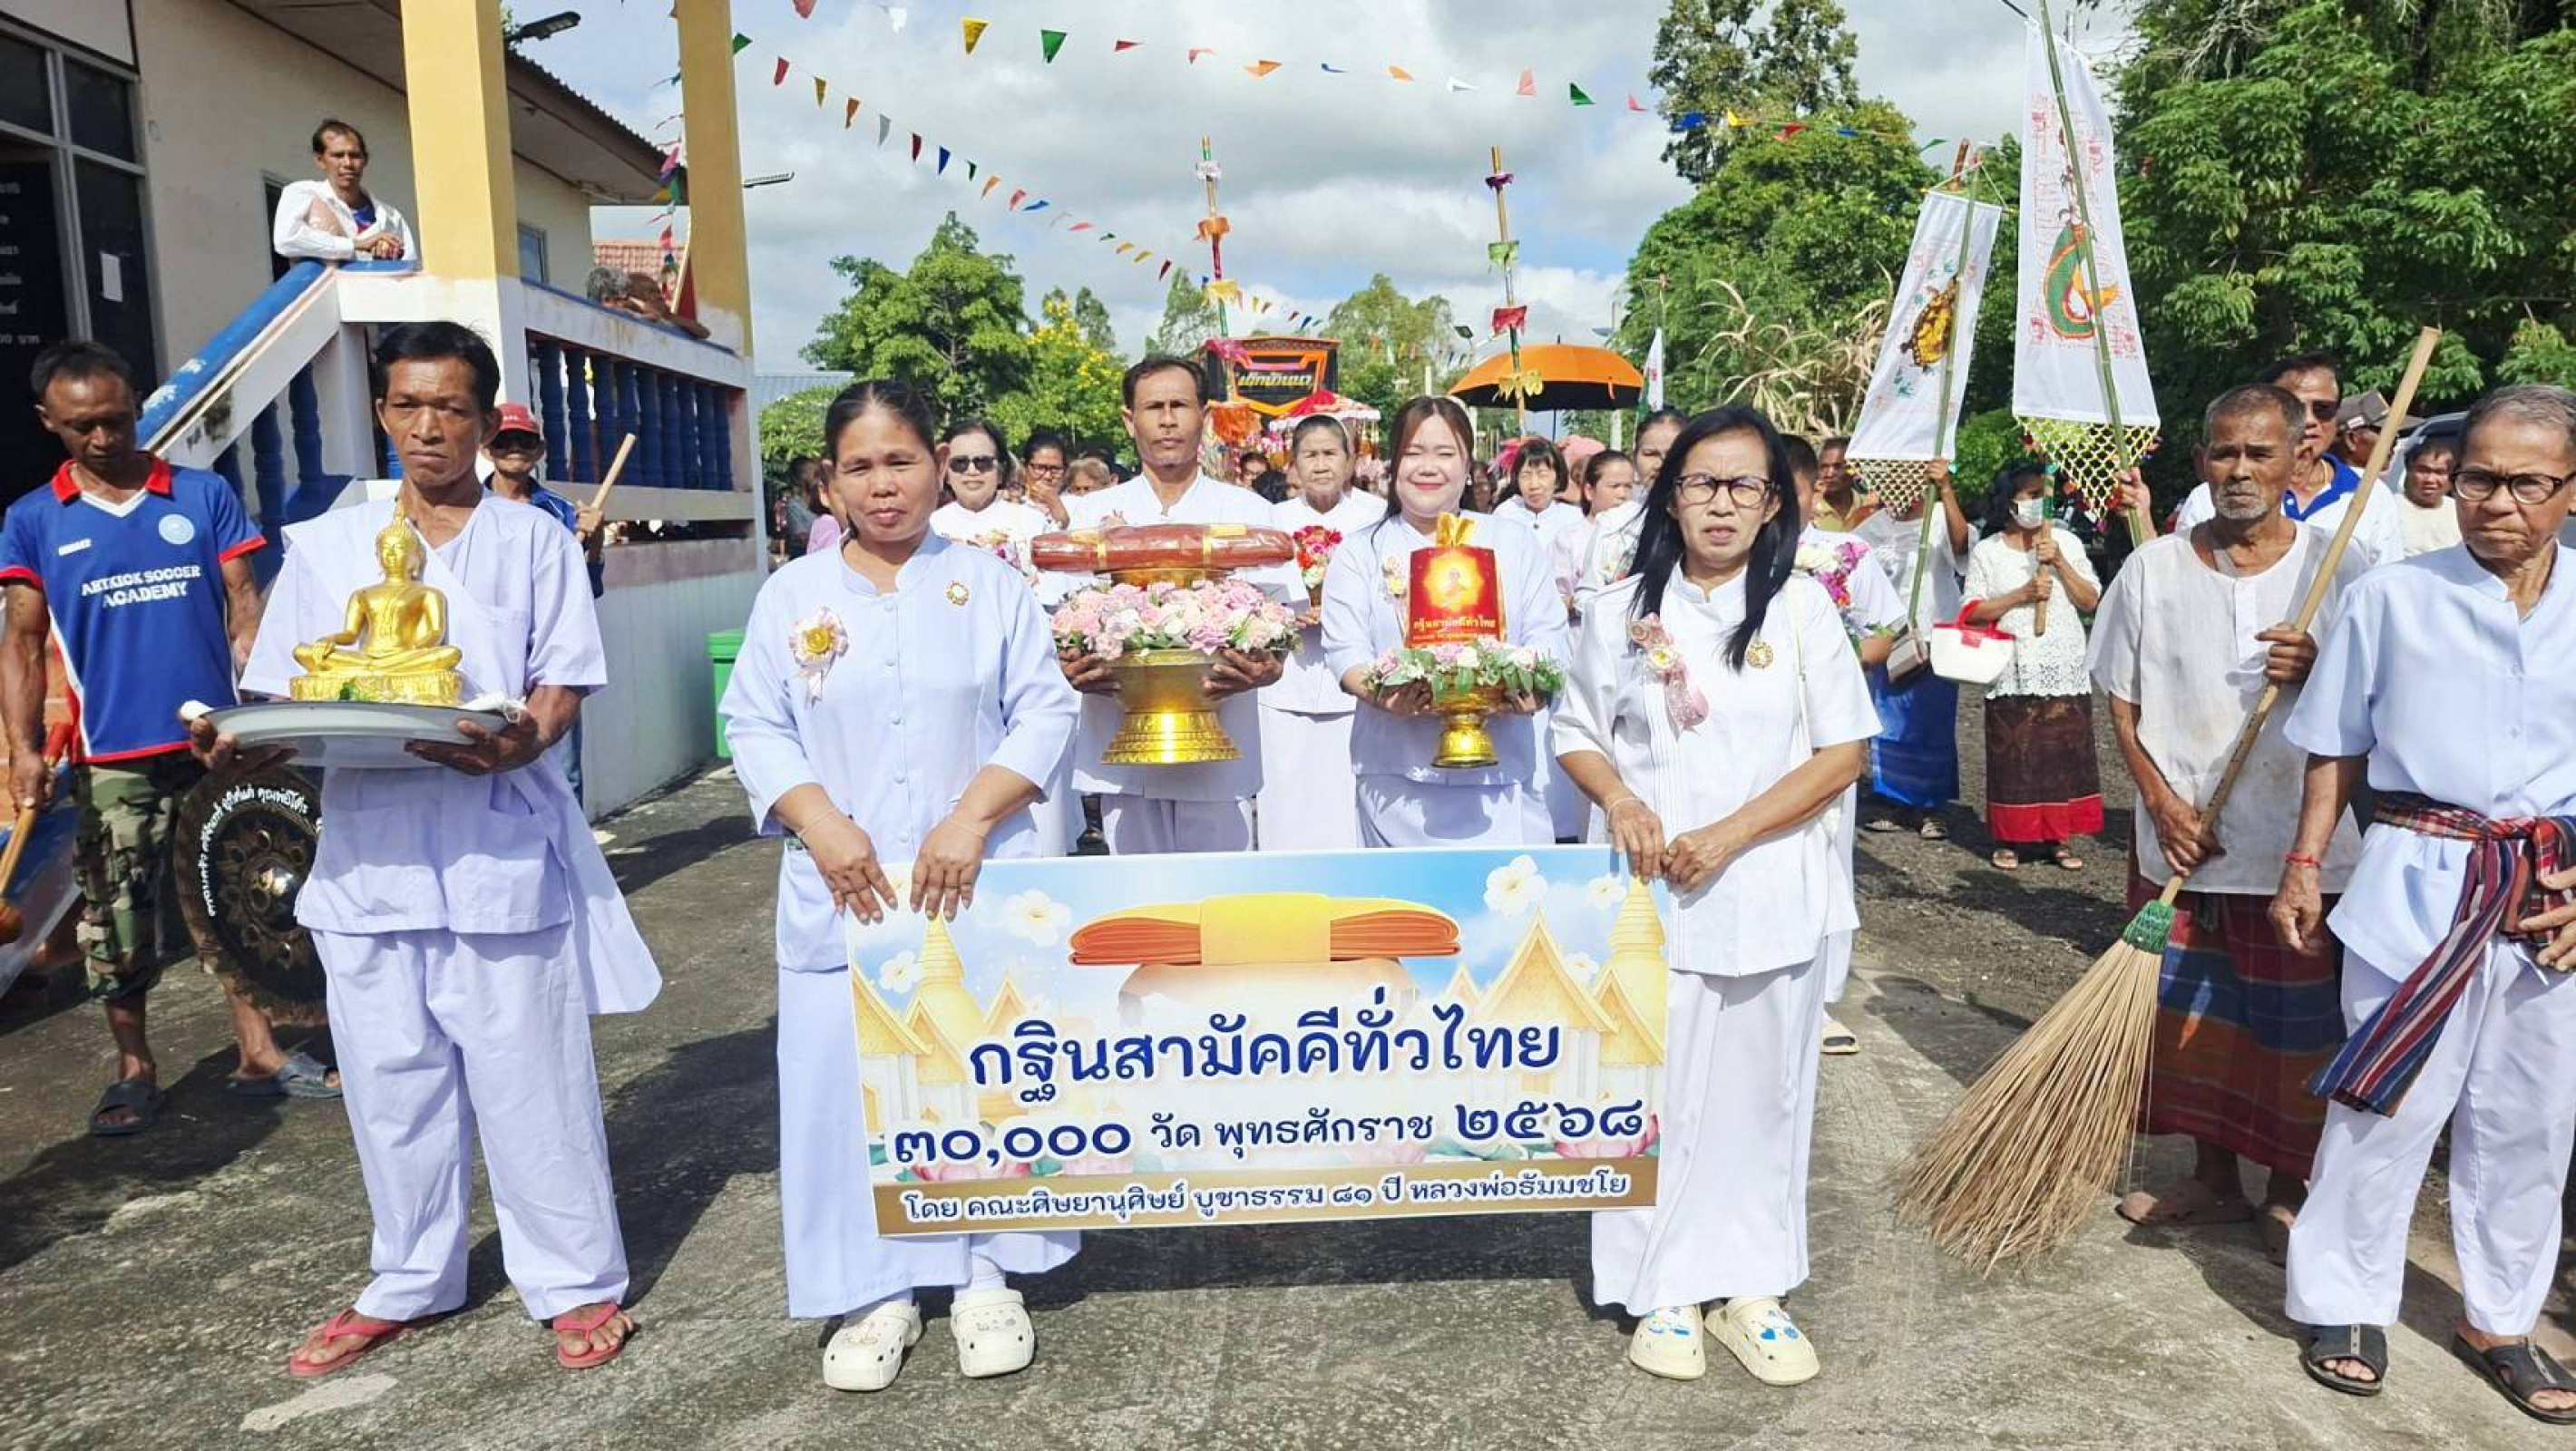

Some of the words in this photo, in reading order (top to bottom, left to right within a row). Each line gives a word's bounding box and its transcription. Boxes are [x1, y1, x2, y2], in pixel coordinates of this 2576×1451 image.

[103, 581, 187, 608] ACADEMY
[143, 565, 200, 585] SOCCER
[970, 986, 1560, 1103] กฐินสามัคคีทั่วไทย
[894, 1124, 1131, 1166] ๓๐,๐๐๐
[1151, 1112, 1200, 1148] วัด
[1215, 1107, 1433, 1159] พุทธศักราช
[1455, 1099, 1643, 1141] ๒๕๖๘
[904, 1194, 958, 1218] โดย
[968, 1184, 1185, 1219] คณะศิษยานุศิษย์
[1195, 1188, 1324, 1216] บูชาธรรม
[1332, 1187, 1372, 1203] ๘๑
[1384, 1176, 1400, 1201] ปี
[1411, 1169, 1626, 1200] หลวงพ่อธัมมชโย
